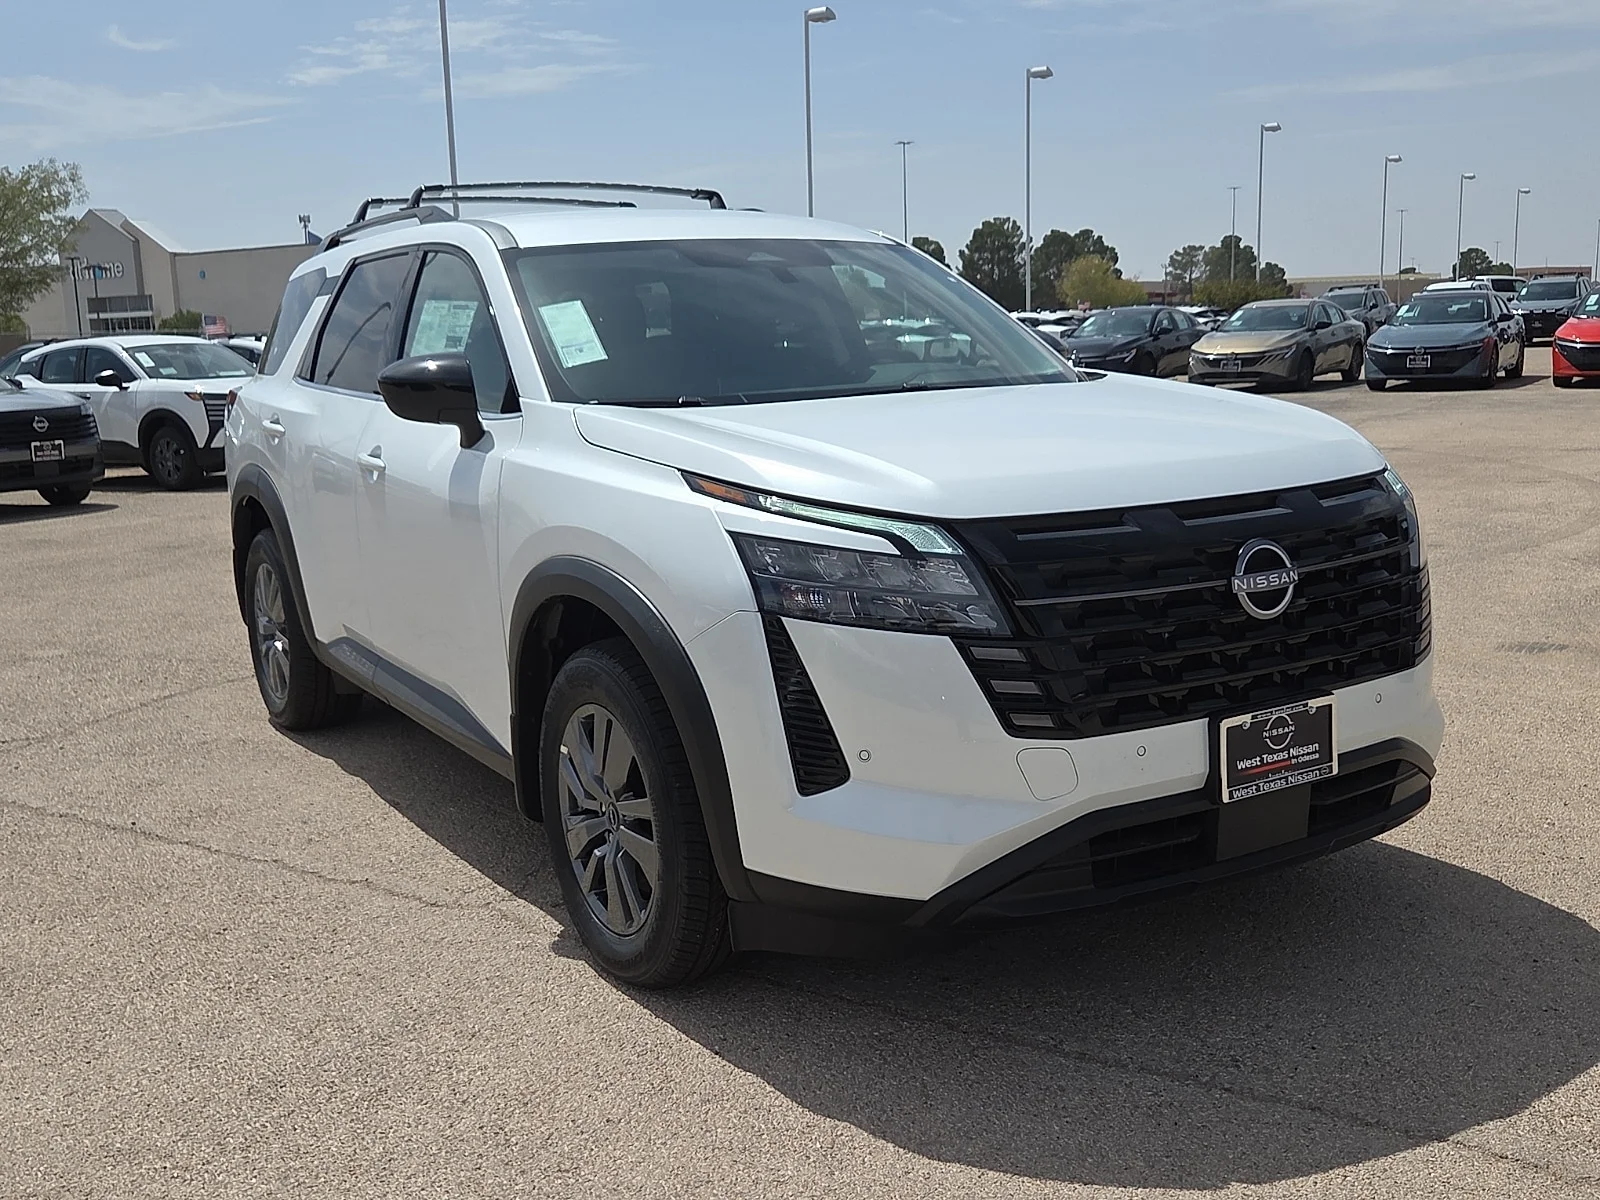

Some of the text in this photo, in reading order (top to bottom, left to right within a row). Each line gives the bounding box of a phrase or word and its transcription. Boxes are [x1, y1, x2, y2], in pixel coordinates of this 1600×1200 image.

[1234, 569, 1298, 590] NISSAN
[1263, 725, 1295, 738] NISSAN
[1236, 743, 1319, 770] West Texas Nissan
[1297, 752, 1320, 763] Odessa
[1232, 784, 1257, 799] West
[1258, 777, 1286, 790] Texas
[1287, 769, 1320, 783] Nissan
